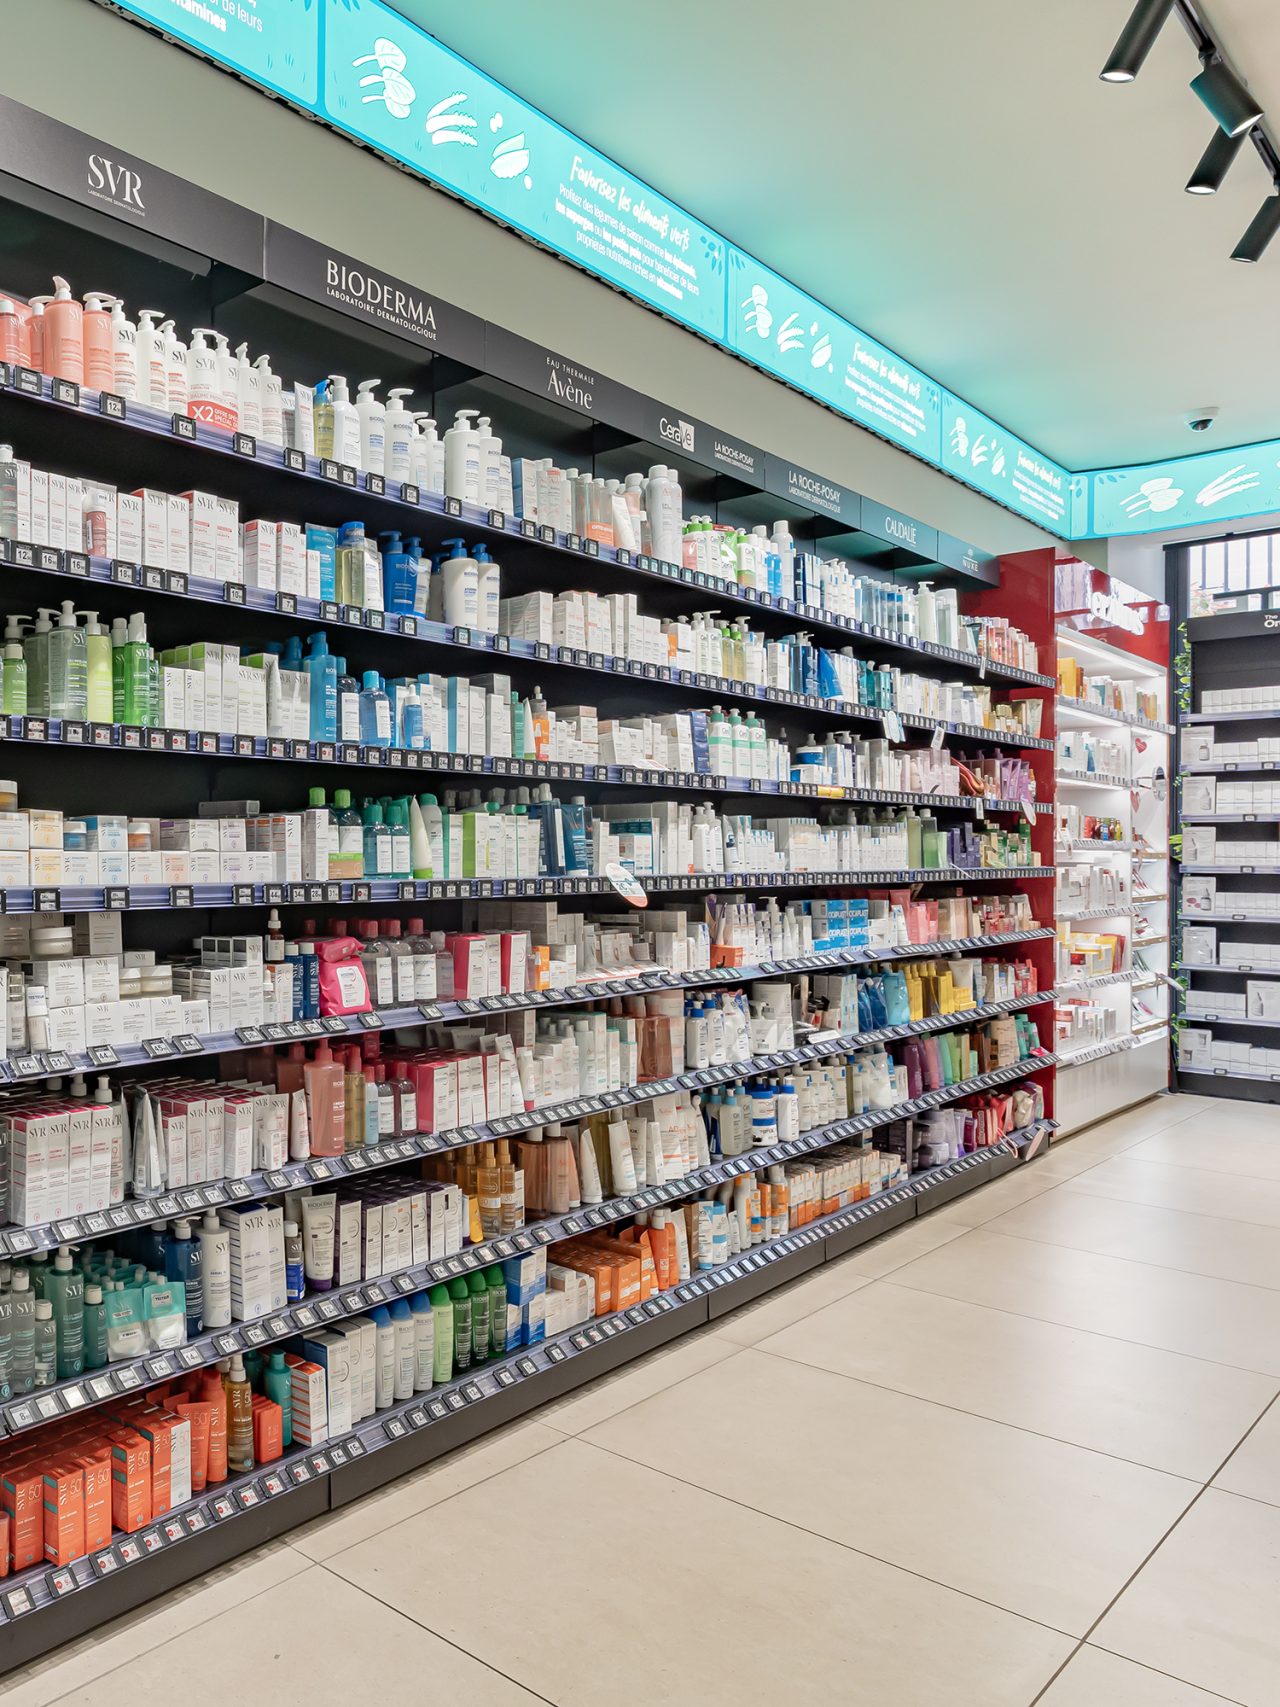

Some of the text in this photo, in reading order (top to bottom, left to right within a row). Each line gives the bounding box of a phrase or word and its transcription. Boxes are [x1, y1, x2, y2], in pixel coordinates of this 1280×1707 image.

[237, 3, 263, 32] leurs
[88, 154, 145, 209] SVR
[559, 183, 582, 203] Profitez
[583, 197, 594, 210] des
[570, 155, 690, 253] Favorisez les aliments verts
[327, 259, 436, 330] BIODERMA
[326, 287, 437, 341] LABORATOIRE DERMATOLOGIQUE
[196, 358, 215, 371] SVR
[547, 357, 595, 386] EAU THERMALE
[547, 369, 593, 410] Avène
[192, 406, 214, 422] X2
[659, 417, 695, 452] CeraVe
[788, 470, 841, 503] LA ROCHE-POSAY
[122, 500, 139, 512] SVR
[197, 497, 214, 510] SVR
[962, 558, 979, 572] NUXE
[29, 1125, 46, 1139] SVR
